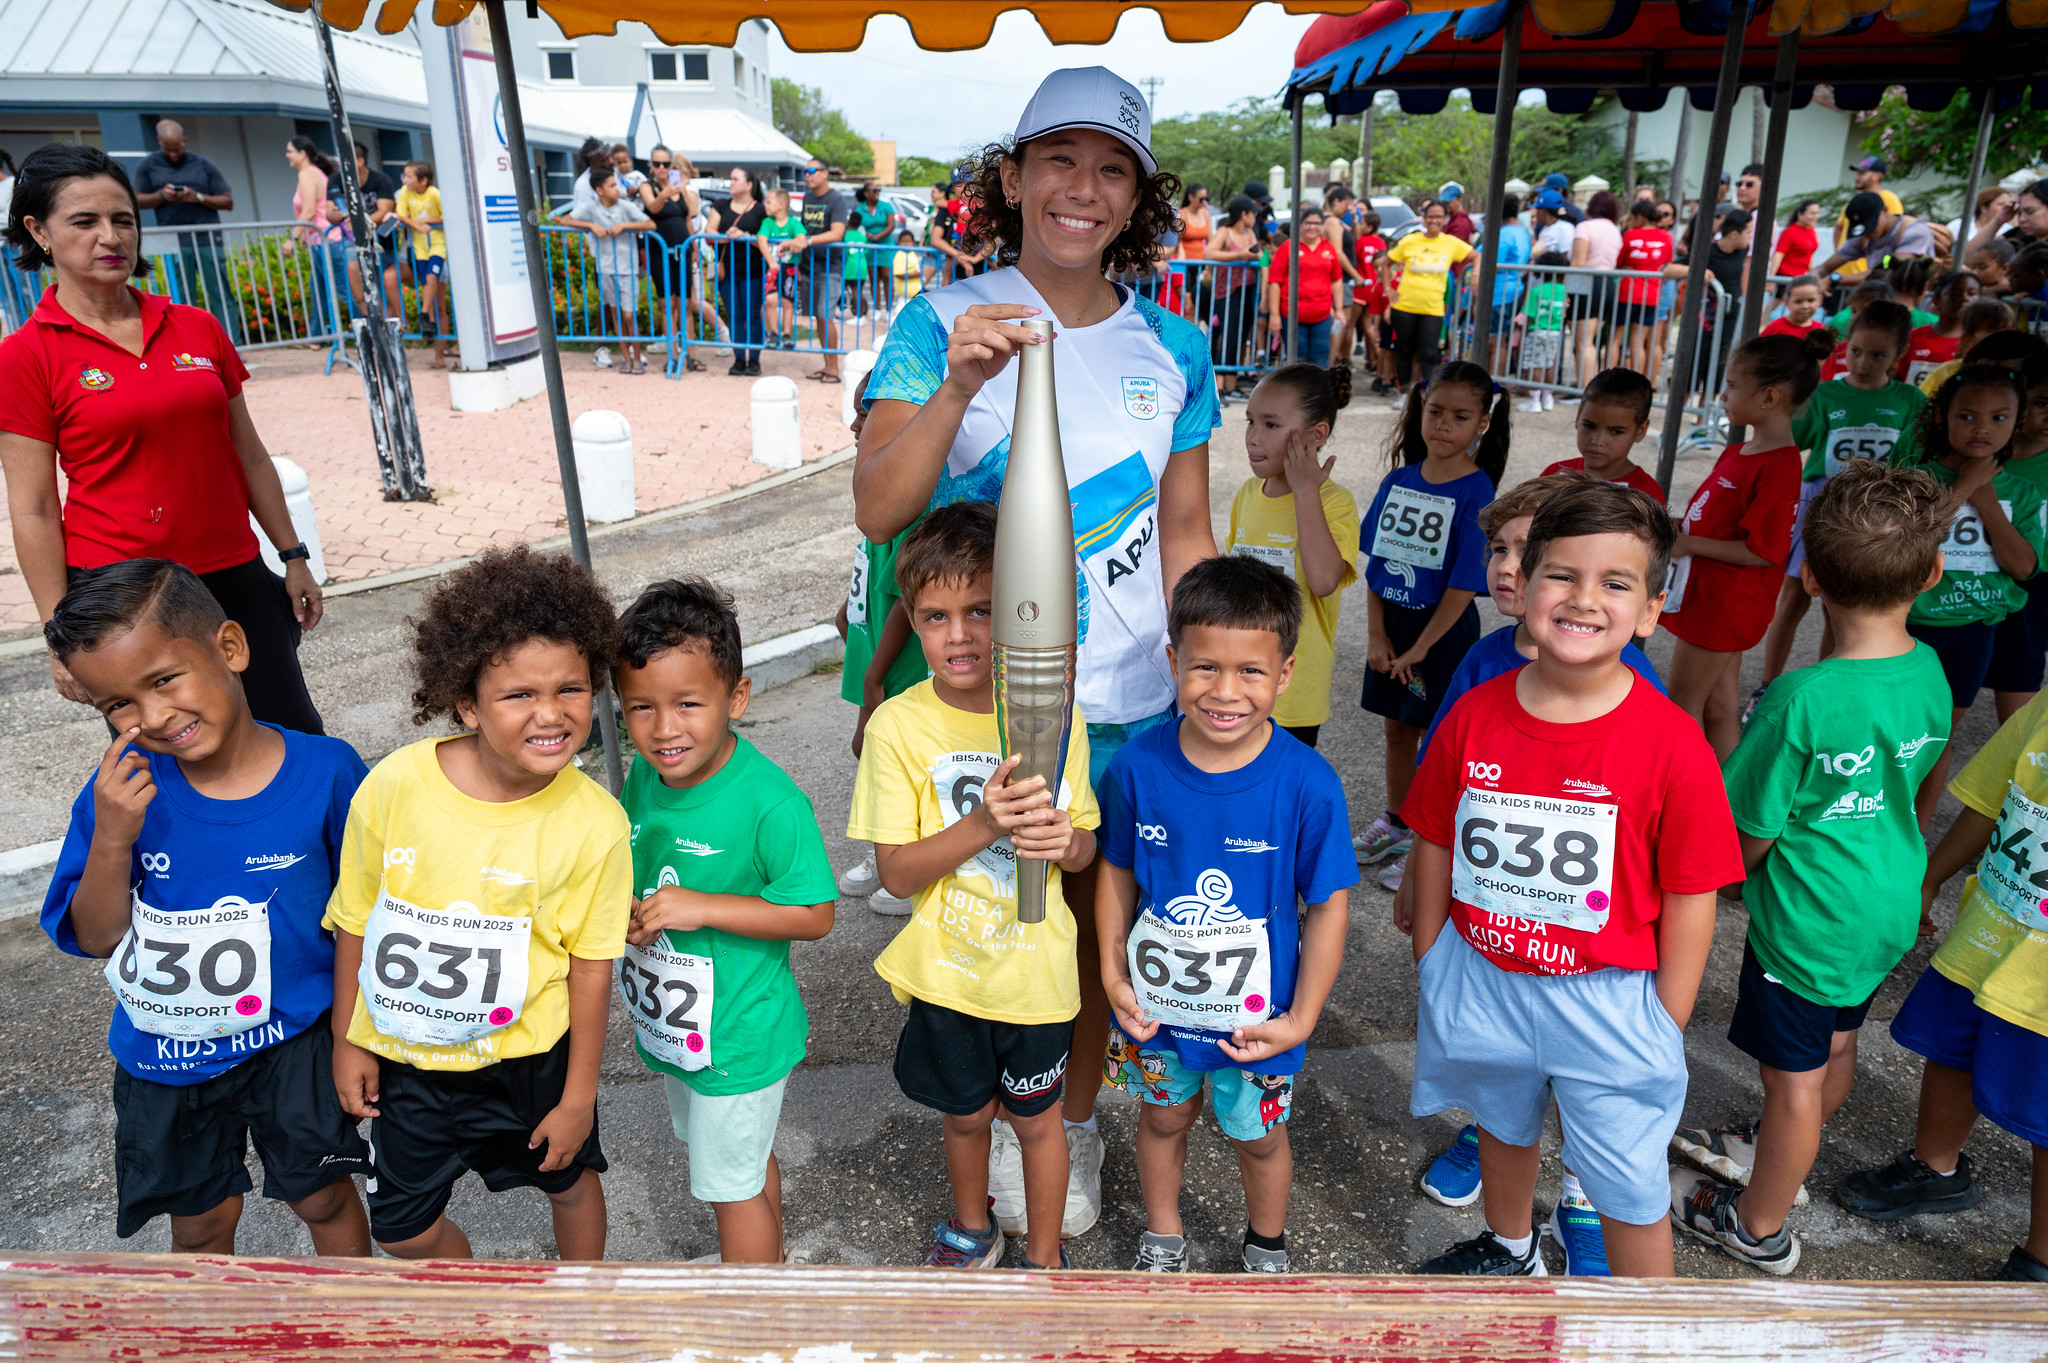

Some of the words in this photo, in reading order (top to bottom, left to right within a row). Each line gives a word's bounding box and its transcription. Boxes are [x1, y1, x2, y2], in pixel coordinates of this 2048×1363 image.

[1118, 111, 1140, 135] 365
[1380, 502, 1444, 543] 658
[1380, 536, 1429, 554] SCHOOLSPORT
[952, 754, 983, 763] IBISA
[1467, 761, 1502, 781] 100
[1563, 778, 1608, 792] Arubabank
[1500, 796, 1531, 809] KIDS
[1534, 800, 1562, 813] RUN
[1565, 804, 1596, 817] 2025
[675, 837, 712, 851] Arubabank
[1224, 837, 1269, 848] Arubabank
[1461, 817, 1599, 886] 638
[245, 853, 295, 865] Arubabank
[1474, 876, 1577, 905] SCHOOLSPORT
[142, 909, 172, 926] KIDS
[177, 914, 210, 926] RUN
[214, 909, 249, 923] 2025
[384, 898, 414, 918] IBISA
[417, 911, 449, 927] KIDS
[453, 918, 481, 930] RUN
[484, 919, 513, 932] 2025
[938, 902, 971, 932] IDS
[981, 921, 1026, 940] RUN
[1167, 926, 1194, 939] KIDS
[1197, 927, 1222, 939] RUN
[1225, 924, 1252, 935] 2025
[966, 937, 987, 951] Own
[991, 943, 1007, 951] the
[1469, 922, 1516, 953] KIDS
[1527, 938, 1576, 967] RUN
[119, 925, 257, 997] 630
[375, 932, 501, 1004] 631
[650, 949, 667, 963] RUN
[669, 955, 694, 967] 2025
[1136, 939, 1258, 996] 637
[937, 958, 967, 975] OLYMPIC
[967, 970, 980, 981] DAY
[119, 988, 231, 1017] SCHOOLSPORT
[621, 956, 698, 1031] 632
[1146, 991, 1241, 1013] SCHOOLSPORT
[1248, 998, 1260, 1009] 36
[241, 1000, 256, 1012] 36
[374, 993, 487, 1023] SCHOOLSPORT
[494, 1010, 507, 1022] 36
[425, 1033, 445, 1041] OLYMPIC
[629, 1010, 685, 1047] SCHOOLSPORT
[1170, 1029, 1201, 1042] OLYMPIC
[1202, 1036, 1217, 1045] DAY
[157, 1037, 217, 1059] KIDS
[231, 1020, 285, 1053] RUN
[369, 1043, 389, 1051] Run
[432, 1051, 455, 1063] Own
[460, 1052, 477, 1063] the
[160, 1063, 178, 1071] the
